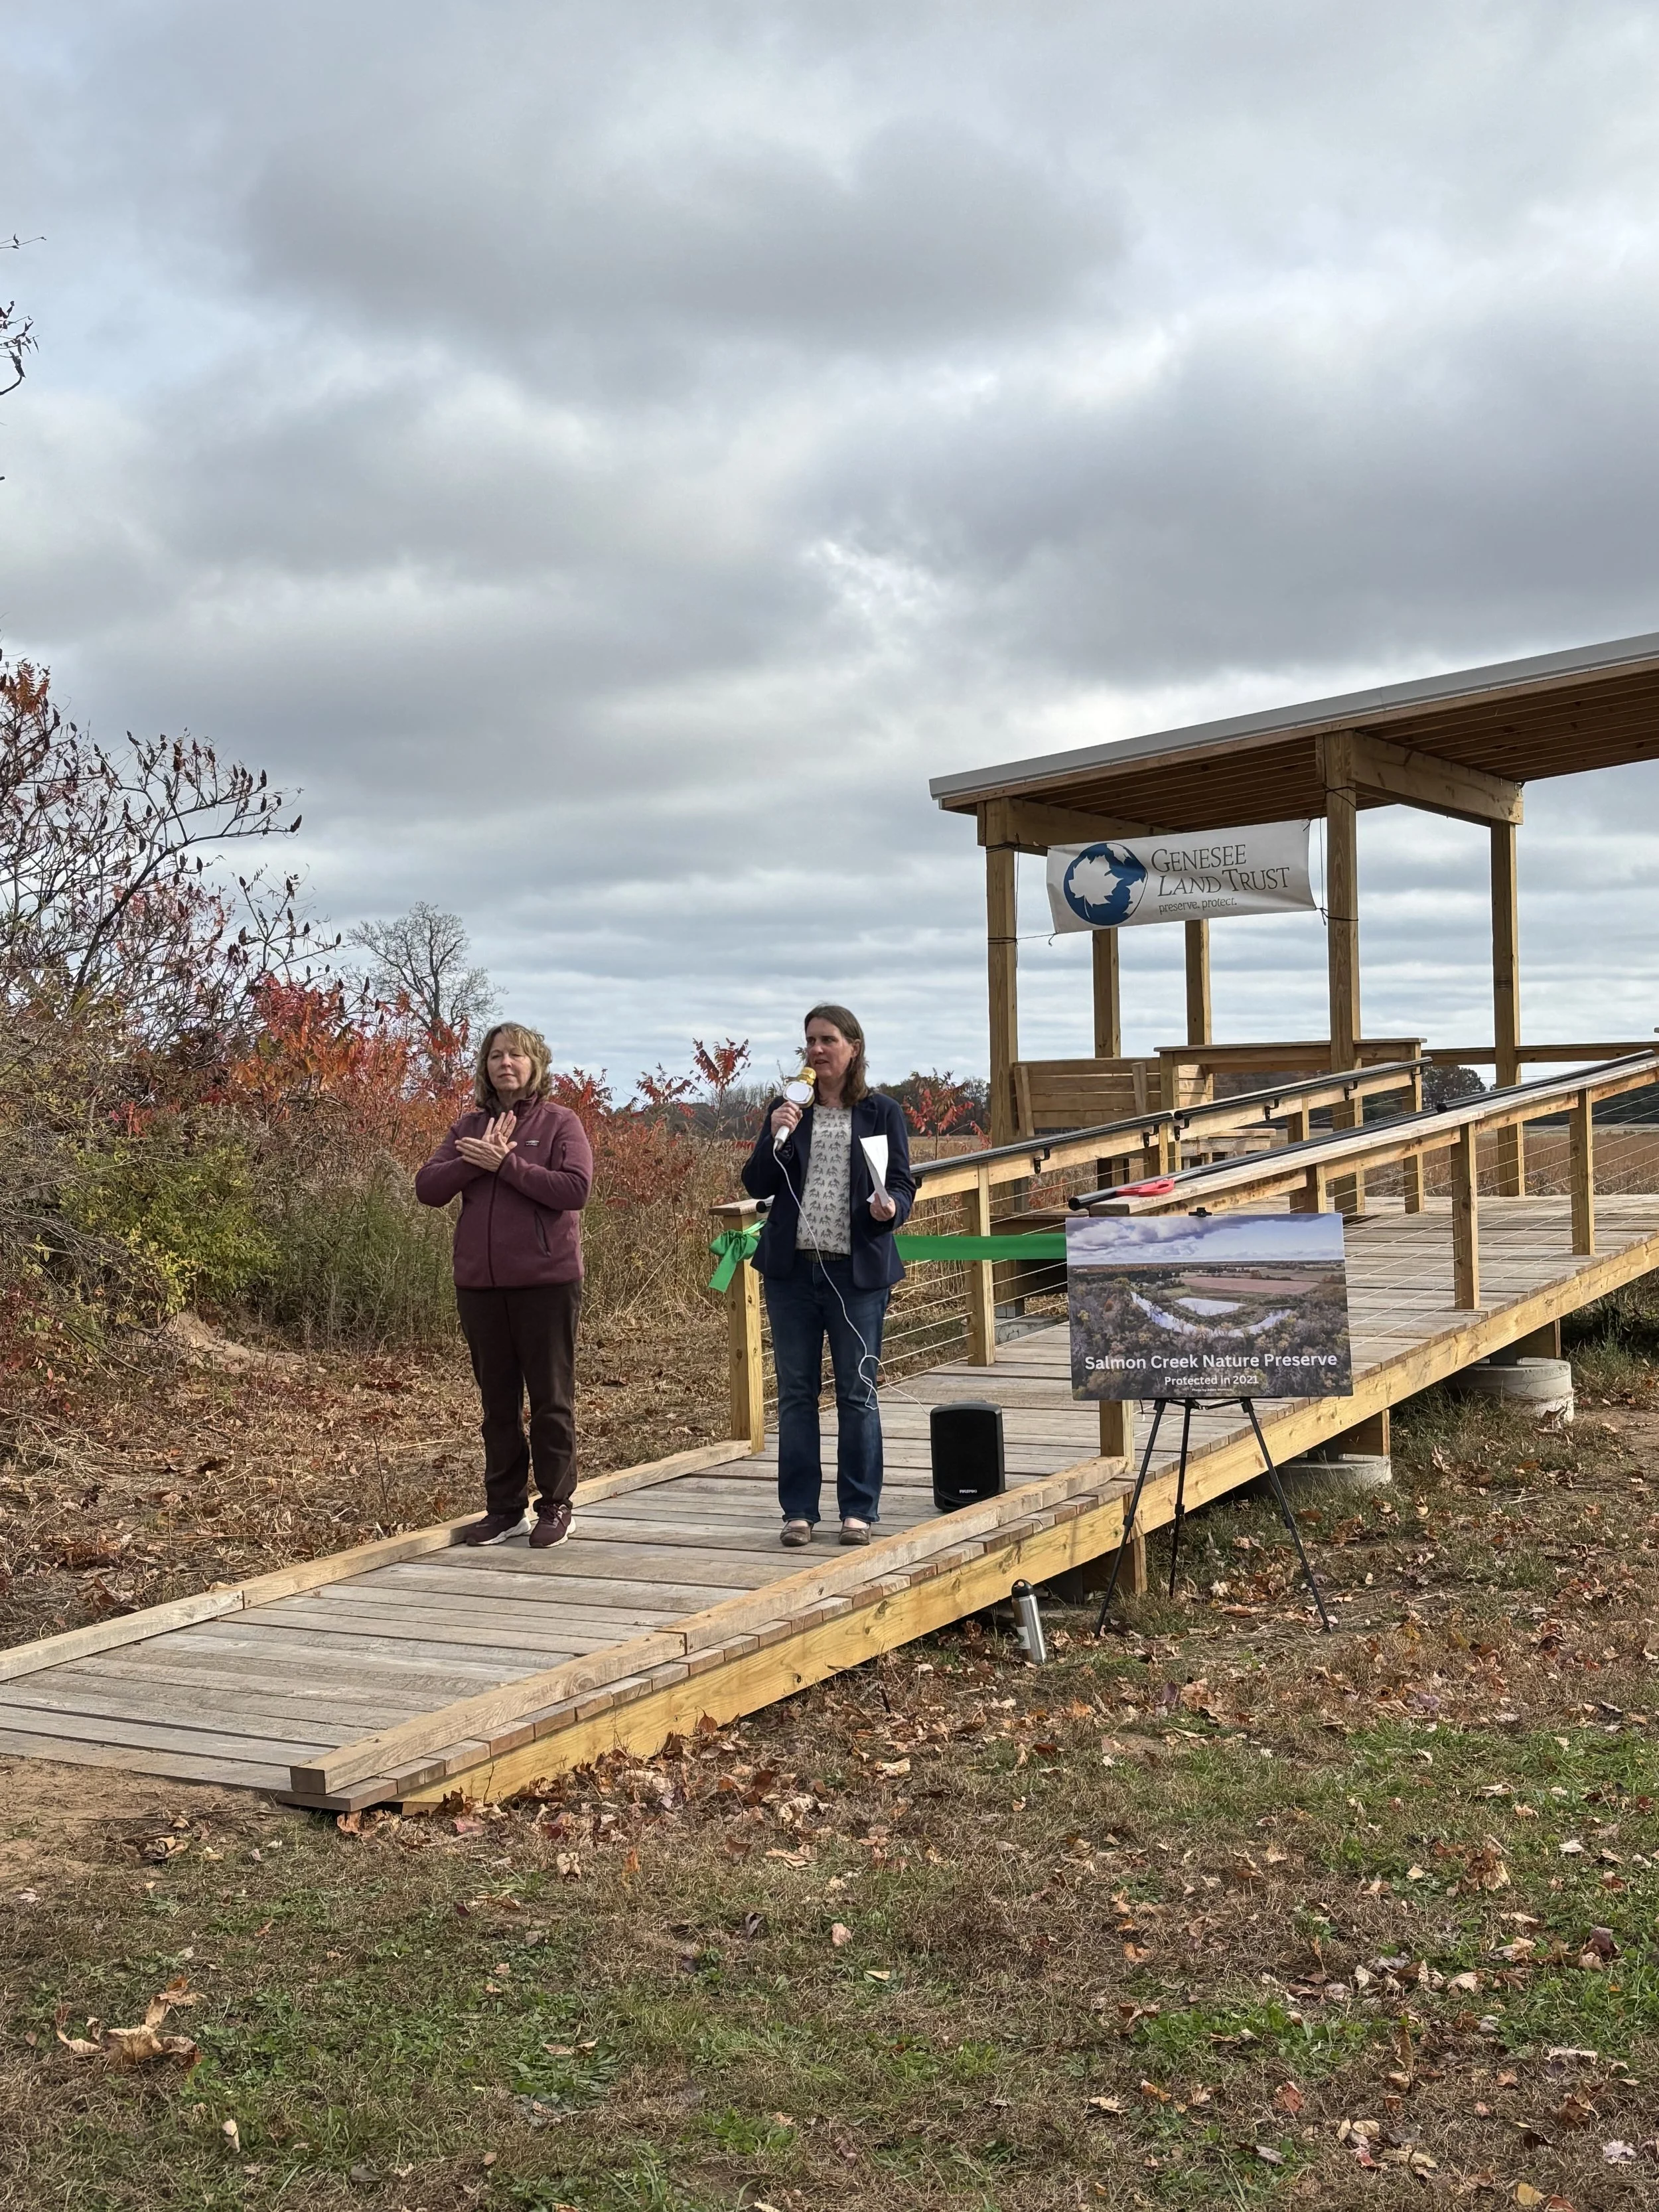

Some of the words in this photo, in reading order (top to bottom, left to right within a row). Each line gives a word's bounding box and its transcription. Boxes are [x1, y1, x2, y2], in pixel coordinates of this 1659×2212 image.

[1151, 844, 1247, 873] GENESEE
[1157, 875, 1222, 897] LAND
[1222, 867, 1290, 892] TRUST
[1159, 900, 1200, 915] preserve.
[1202, 897, 1237, 911] protect.
[1085, 1356, 1146, 1370] Salmon
[1151, 1355, 1198, 1369] Creek
[1202, 1354, 1260, 1368] Nature
[1264, 1353, 1338, 1367] Preserve
[1165, 1375, 1218, 1386] Protected
[1220, 1375, 1230, 1385] in
[1233, 1375, 1259, 1384] 2021
